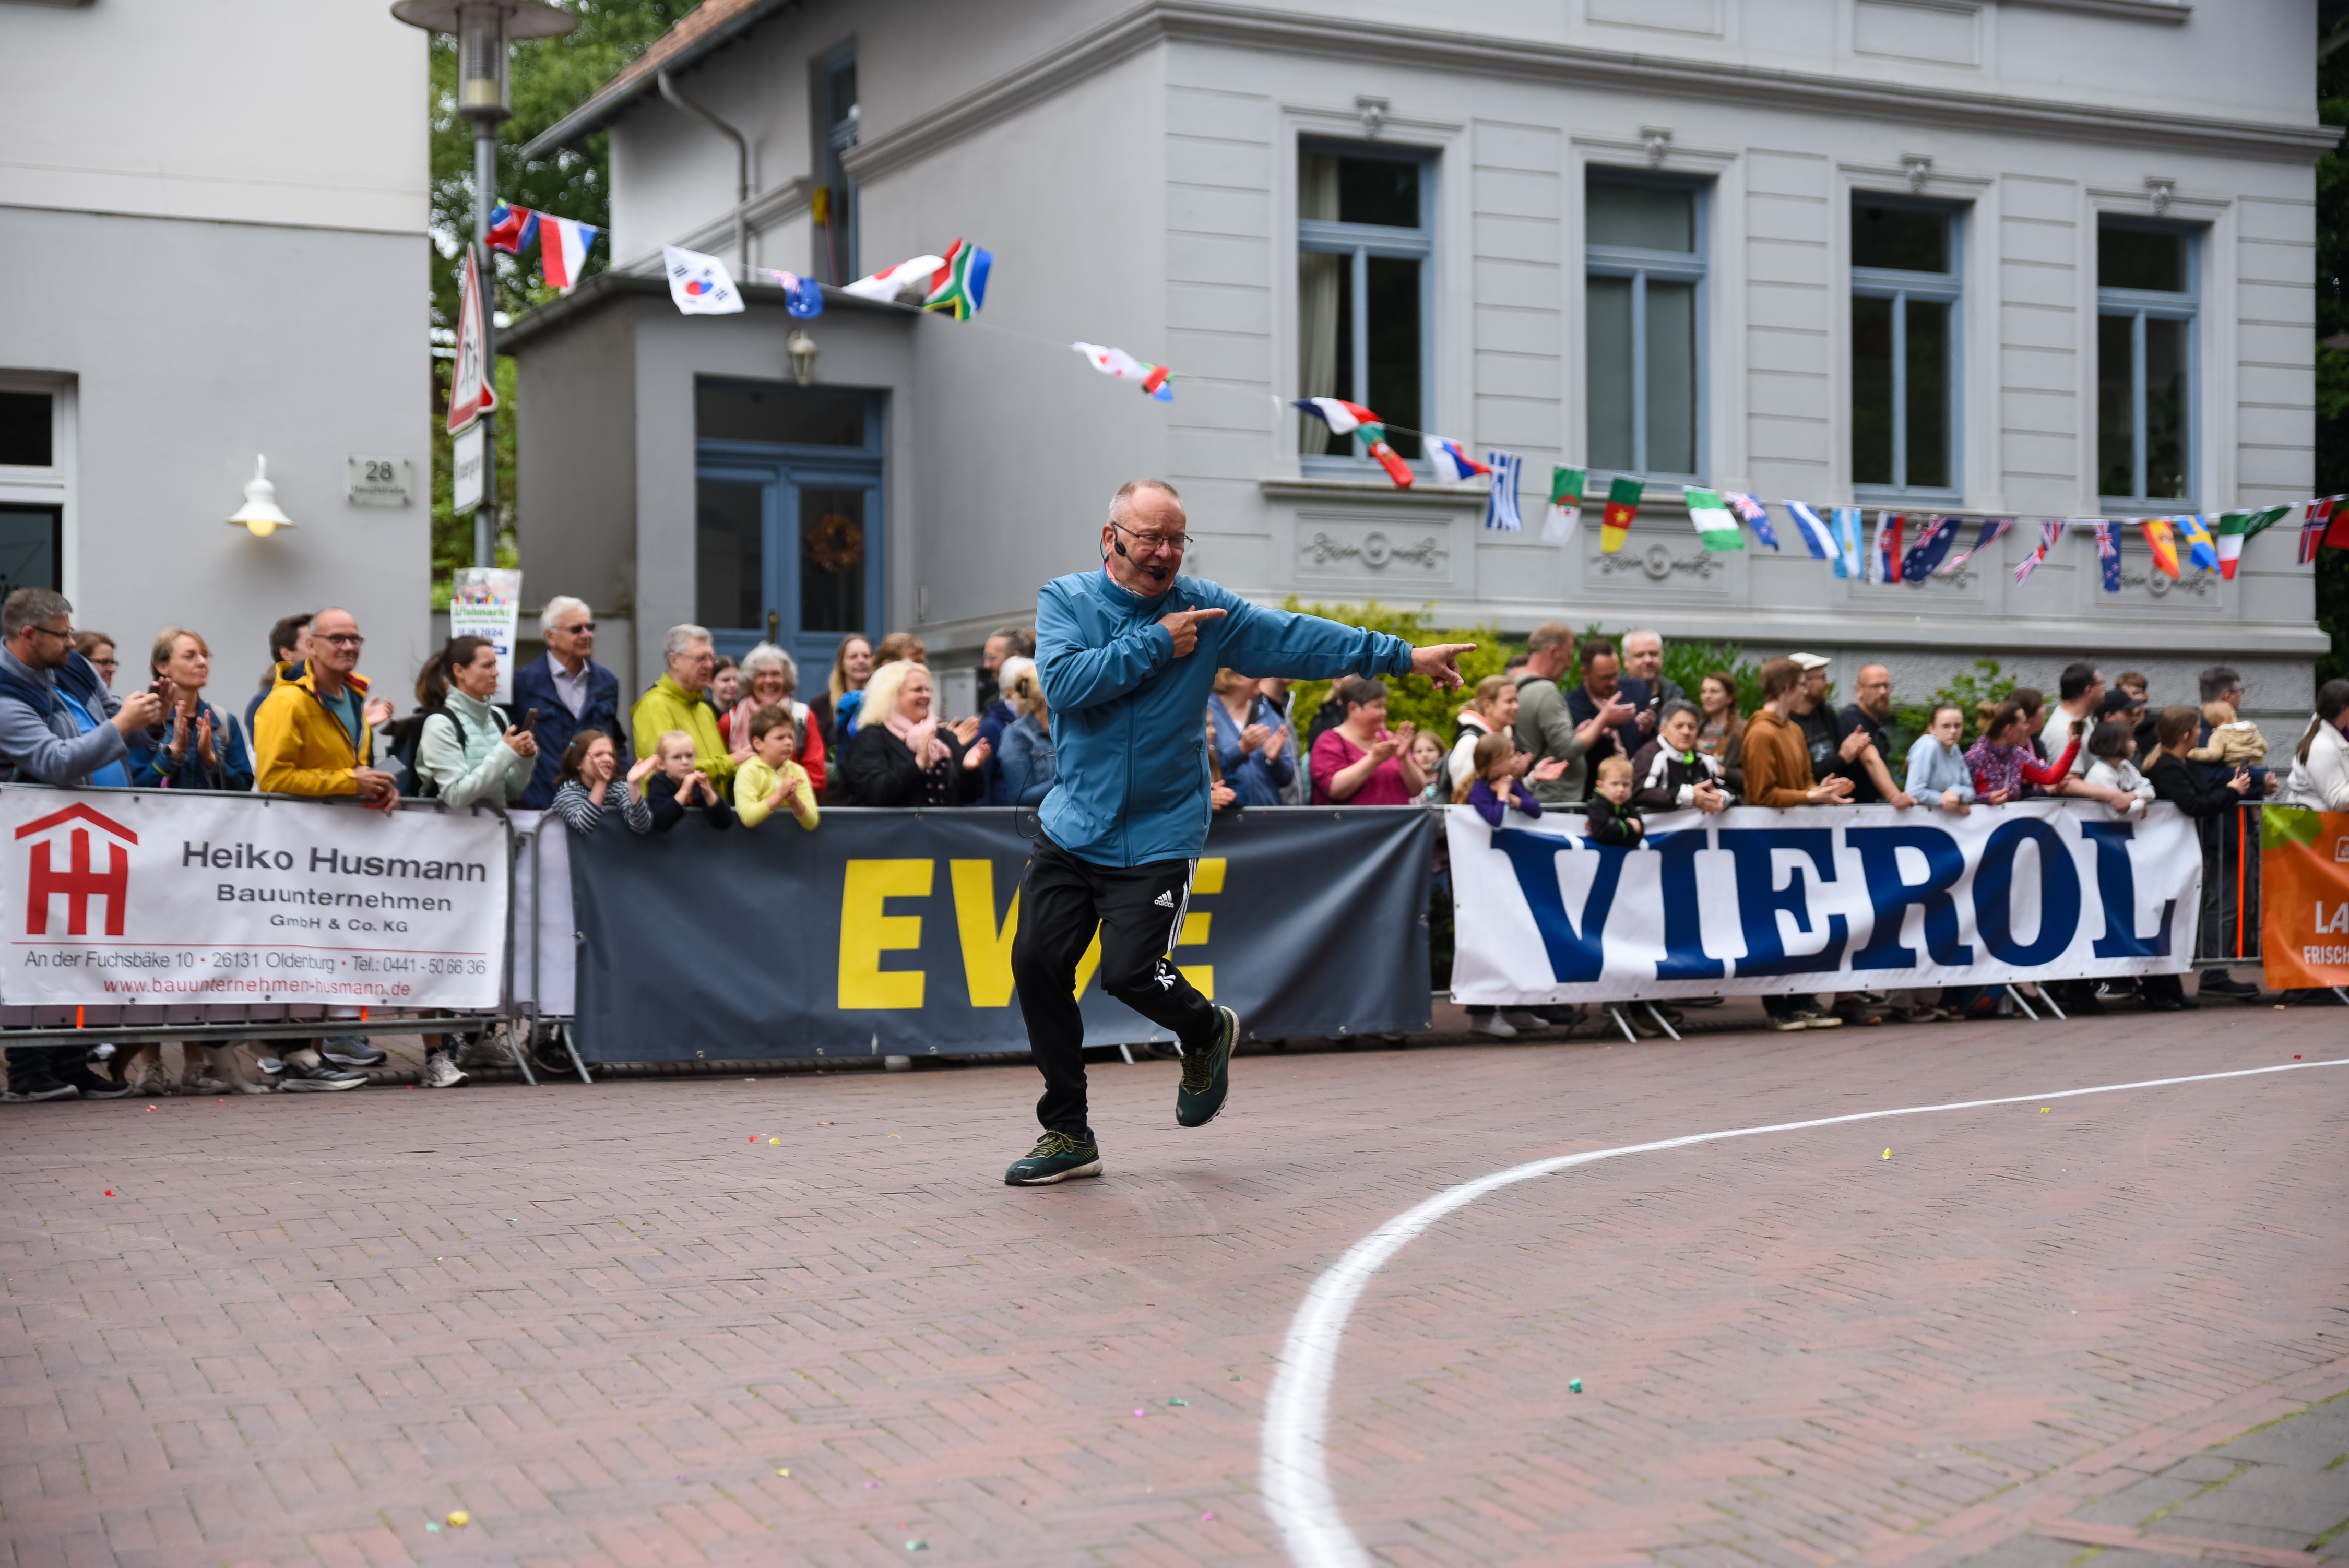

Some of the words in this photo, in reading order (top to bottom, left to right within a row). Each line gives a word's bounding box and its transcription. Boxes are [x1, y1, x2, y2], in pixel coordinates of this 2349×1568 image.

[365, 460, 393, 481] 28
[182, 840, 294, 871] Heiko
[309, 846, 487, 882] Husmann
[216, 883, 452, 912] Bauunternehmen
[1154, 899, 1174, 908] adidas
[1491, 817, 2175, 983] VIEROL
[269, 914, 321, 929] GmbH
[327, 918, 341, 930] &
[347, 919, 377, 932] Co.
[383, 920, 408, 933] KG
[24, 949, 48, 967] An
[52, 950, 80, 967] der
[85, 950, 170, 968] Fuchsbäke
[176, 951, 194, 968] 10
[212, 951, 259, 968] 26131
[266, 951, 335, 973] Oldenburg
[351, 955, 379, 972] Tel.:
[383, 956, 416, 973] 0441
[428, 958, 444, 974] 50
[447, 959, 462, 975] 66
[467, 959, 486, 975] 36
[103, 976, 410, 996] www.bauunternehmen-husmann.de
